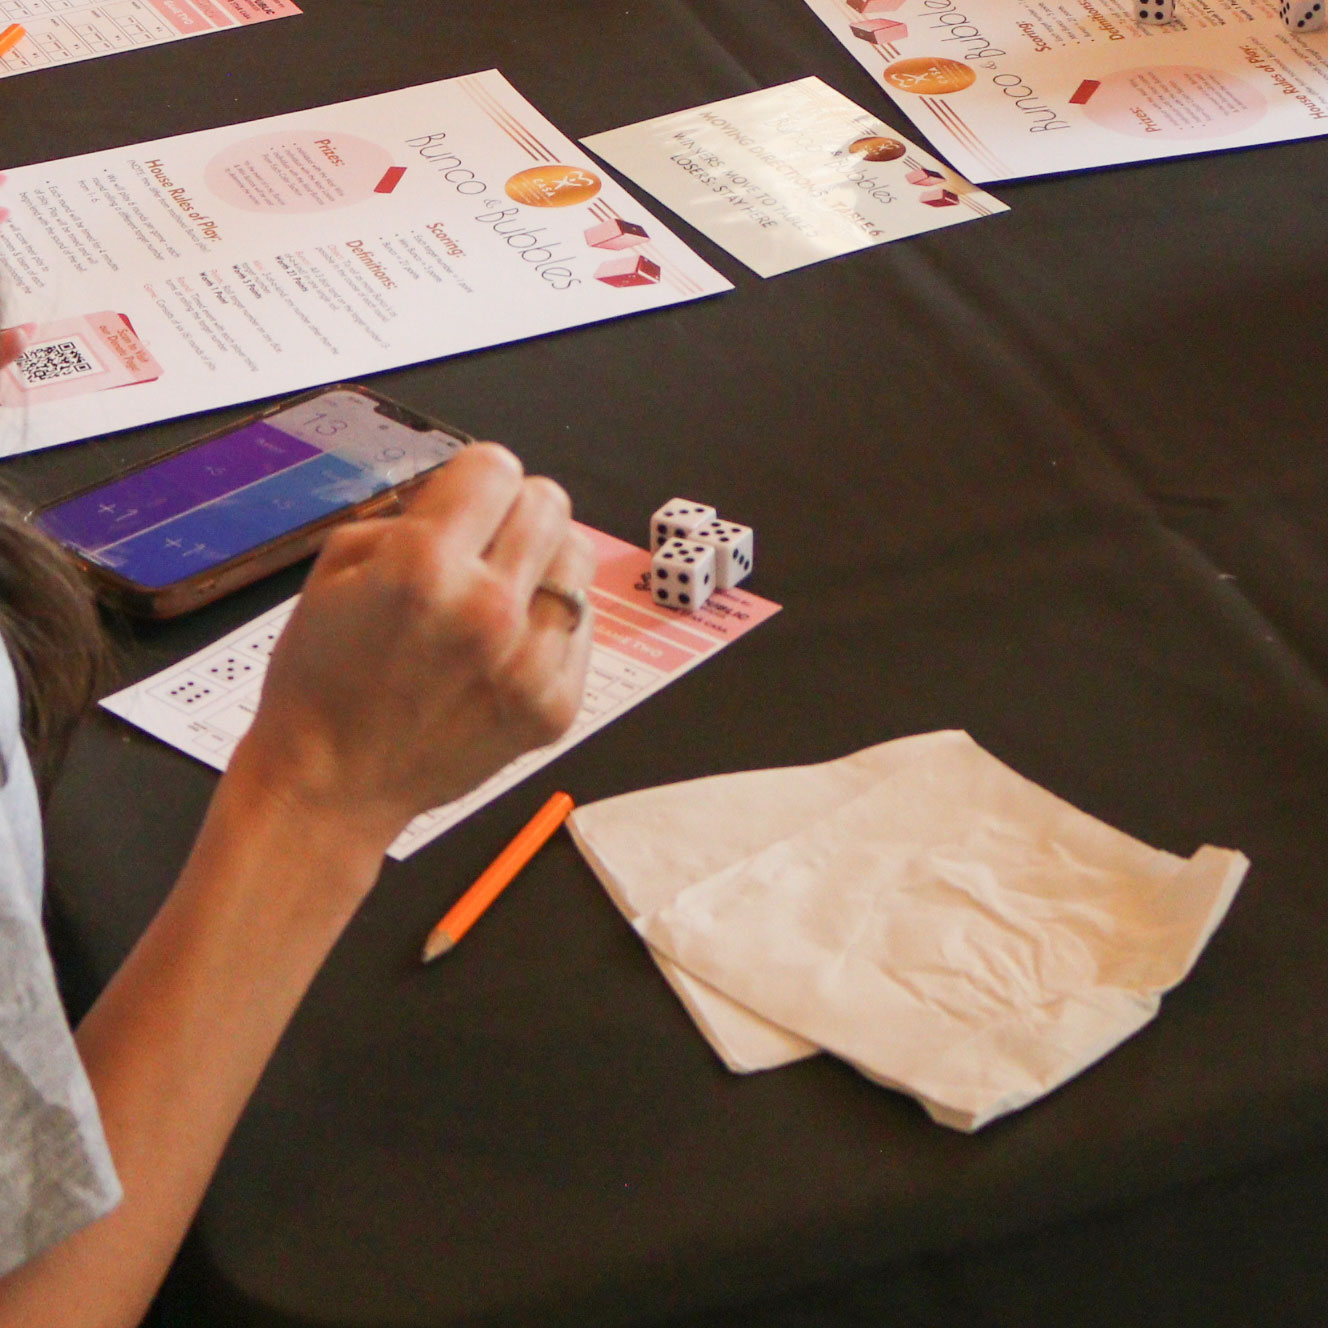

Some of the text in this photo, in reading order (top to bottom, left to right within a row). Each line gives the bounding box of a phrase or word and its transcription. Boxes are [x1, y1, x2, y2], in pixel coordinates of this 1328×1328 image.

[1080, 1, 1124, 40] Definitions:
[1016, 21, 1052, 52] Scoring:
[976, 60, 1001, 71] &
[1239, 44, 1264, 64] Play:
[1254, 64, 1275, 72] of
[925, 66, 951, 84] CASA
[1270, 73, 1298, 94] Rules
[992, 73, 1067, 132] Bunco
[1294, 94, 1327, 119] House
[1128, 106, 1160, 132] Prizes:
[314, 138, 344, 166] Prizes:
[406, 132, 486, 194] Bunco
[528, 177, 559, 197] CASA
[697, 110, 757, 146] MOVING
[866, 228, 886, 237] 6
[719, 168, 762, 194] MOVE
[751, 192, 780, 206] TO
[144, 158, 230, 243] House Rules of Play:
[479, 196, 506, 209] &
[710, 184, 750, 207] STAY
[738, 205, 779, 228] HERE
[425, 222, 464, 257] Scoring:
[475, 207, 599, 289] Bubbles
[345, 239, 395, 288] Definitions:
[292, 410, 356, 438] 13
[88, 496, 144, 524] +1
[154, 530, 212, 560] +1
